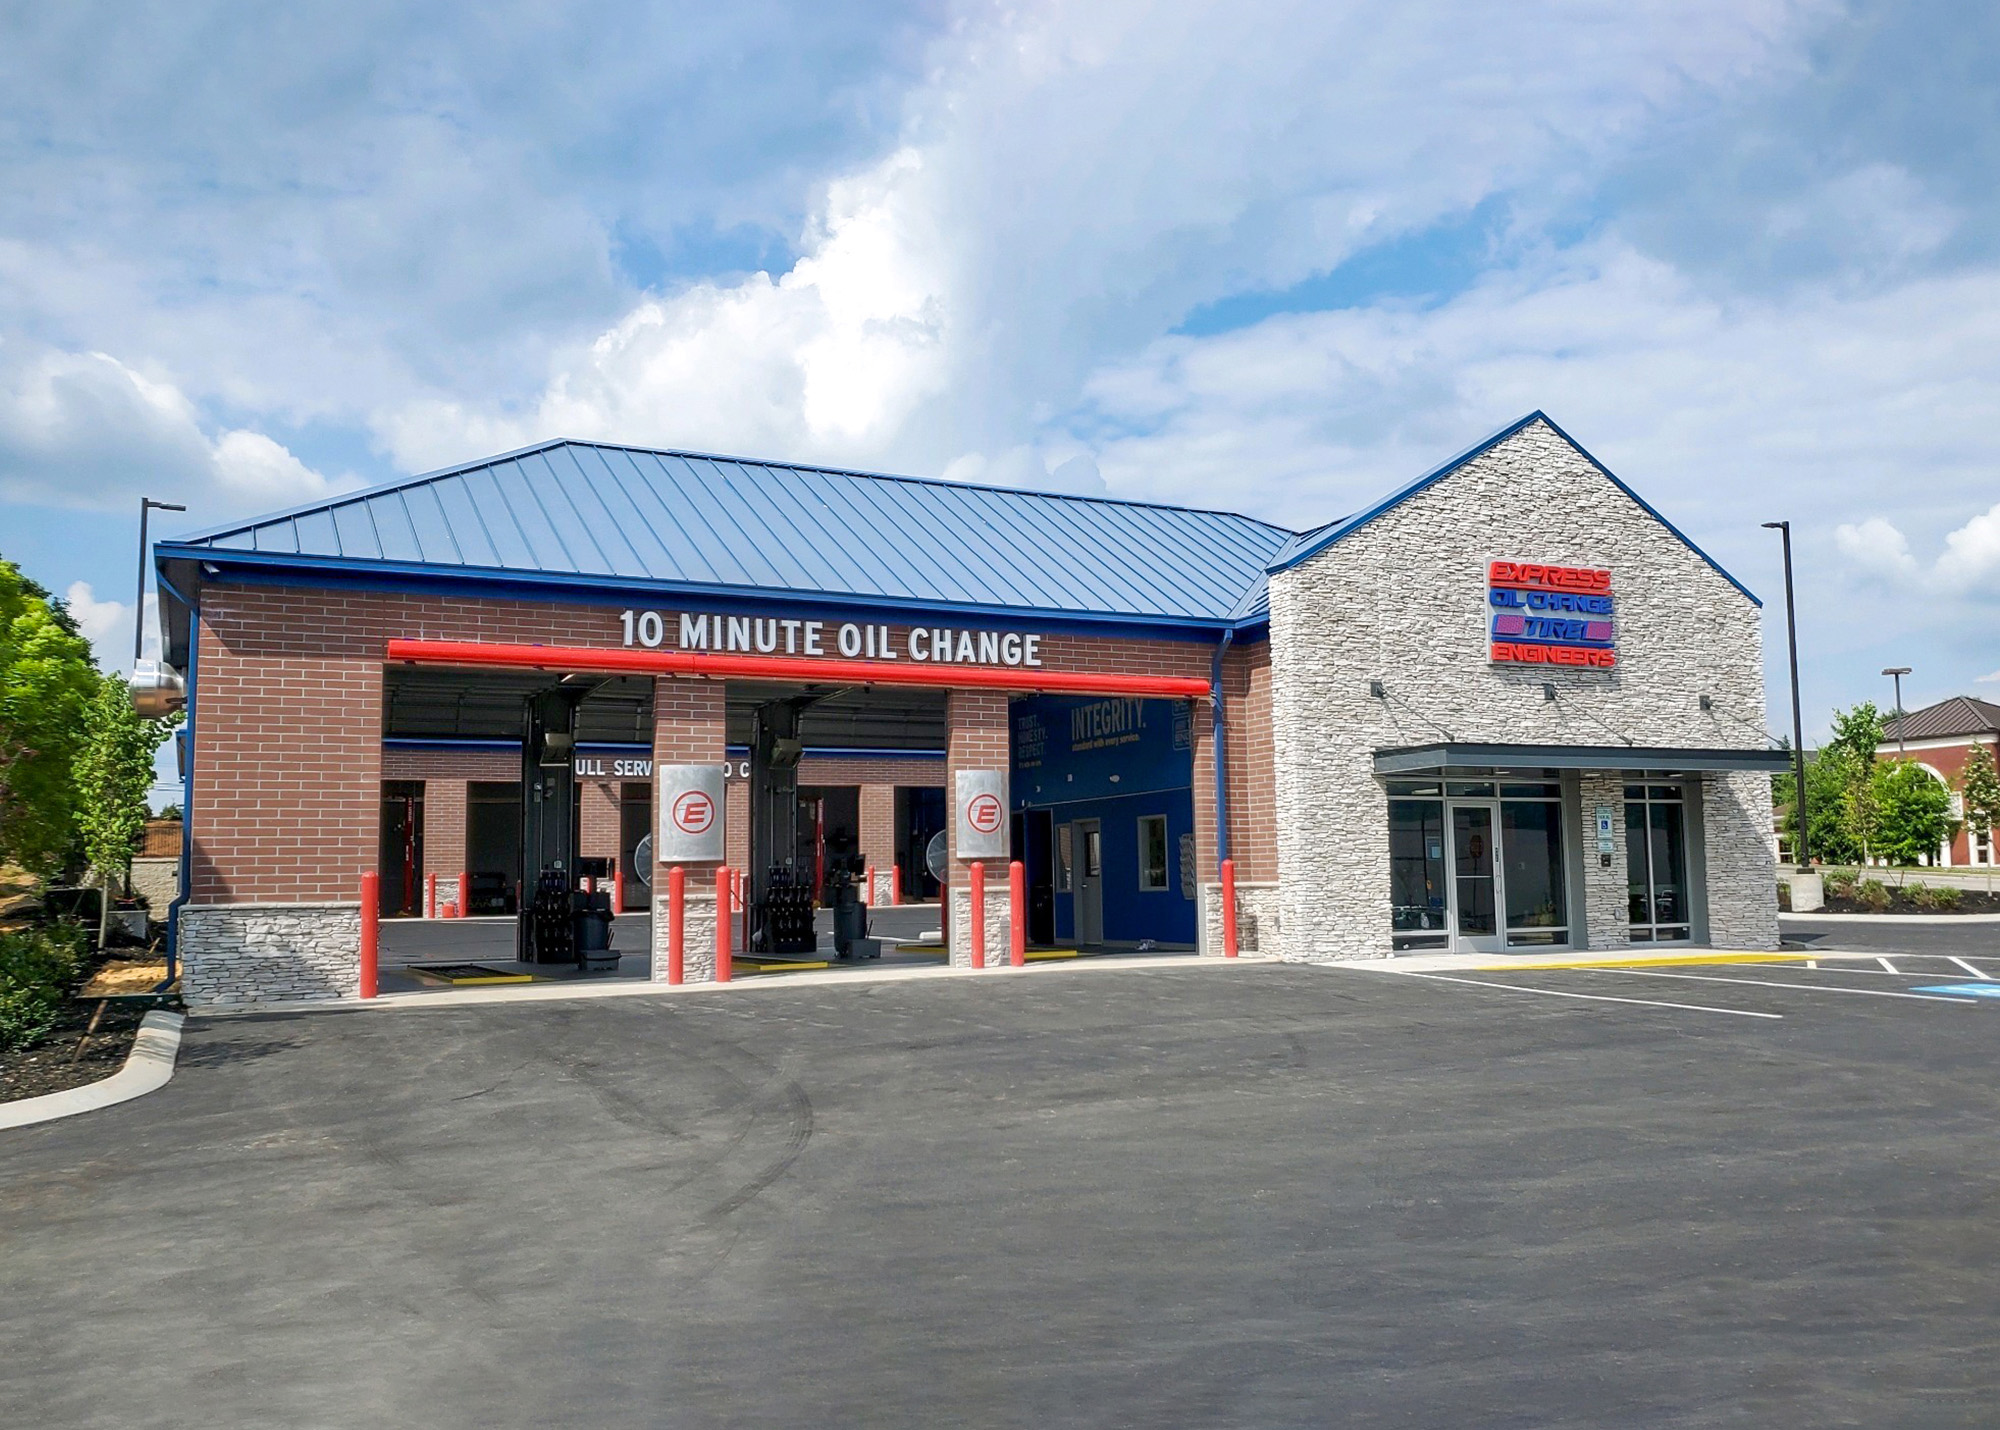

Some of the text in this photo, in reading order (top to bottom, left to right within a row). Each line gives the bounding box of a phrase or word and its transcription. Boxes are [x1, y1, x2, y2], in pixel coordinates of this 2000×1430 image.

[1490, 561, 1611, 588] EXPRESS
[1490, 588, 1614, 614] OIL CHANGE
[620, 609, 1042, 666] 10 MINUTE OIL CHANGE
[1525, 616, 1585, 640] TIRE
[1491, 642, 1615, 667] ENGINEERS
[1071, 697, 1147, 741] INTEGRITY.
[575, 759, 653, 777] ULL SERV
